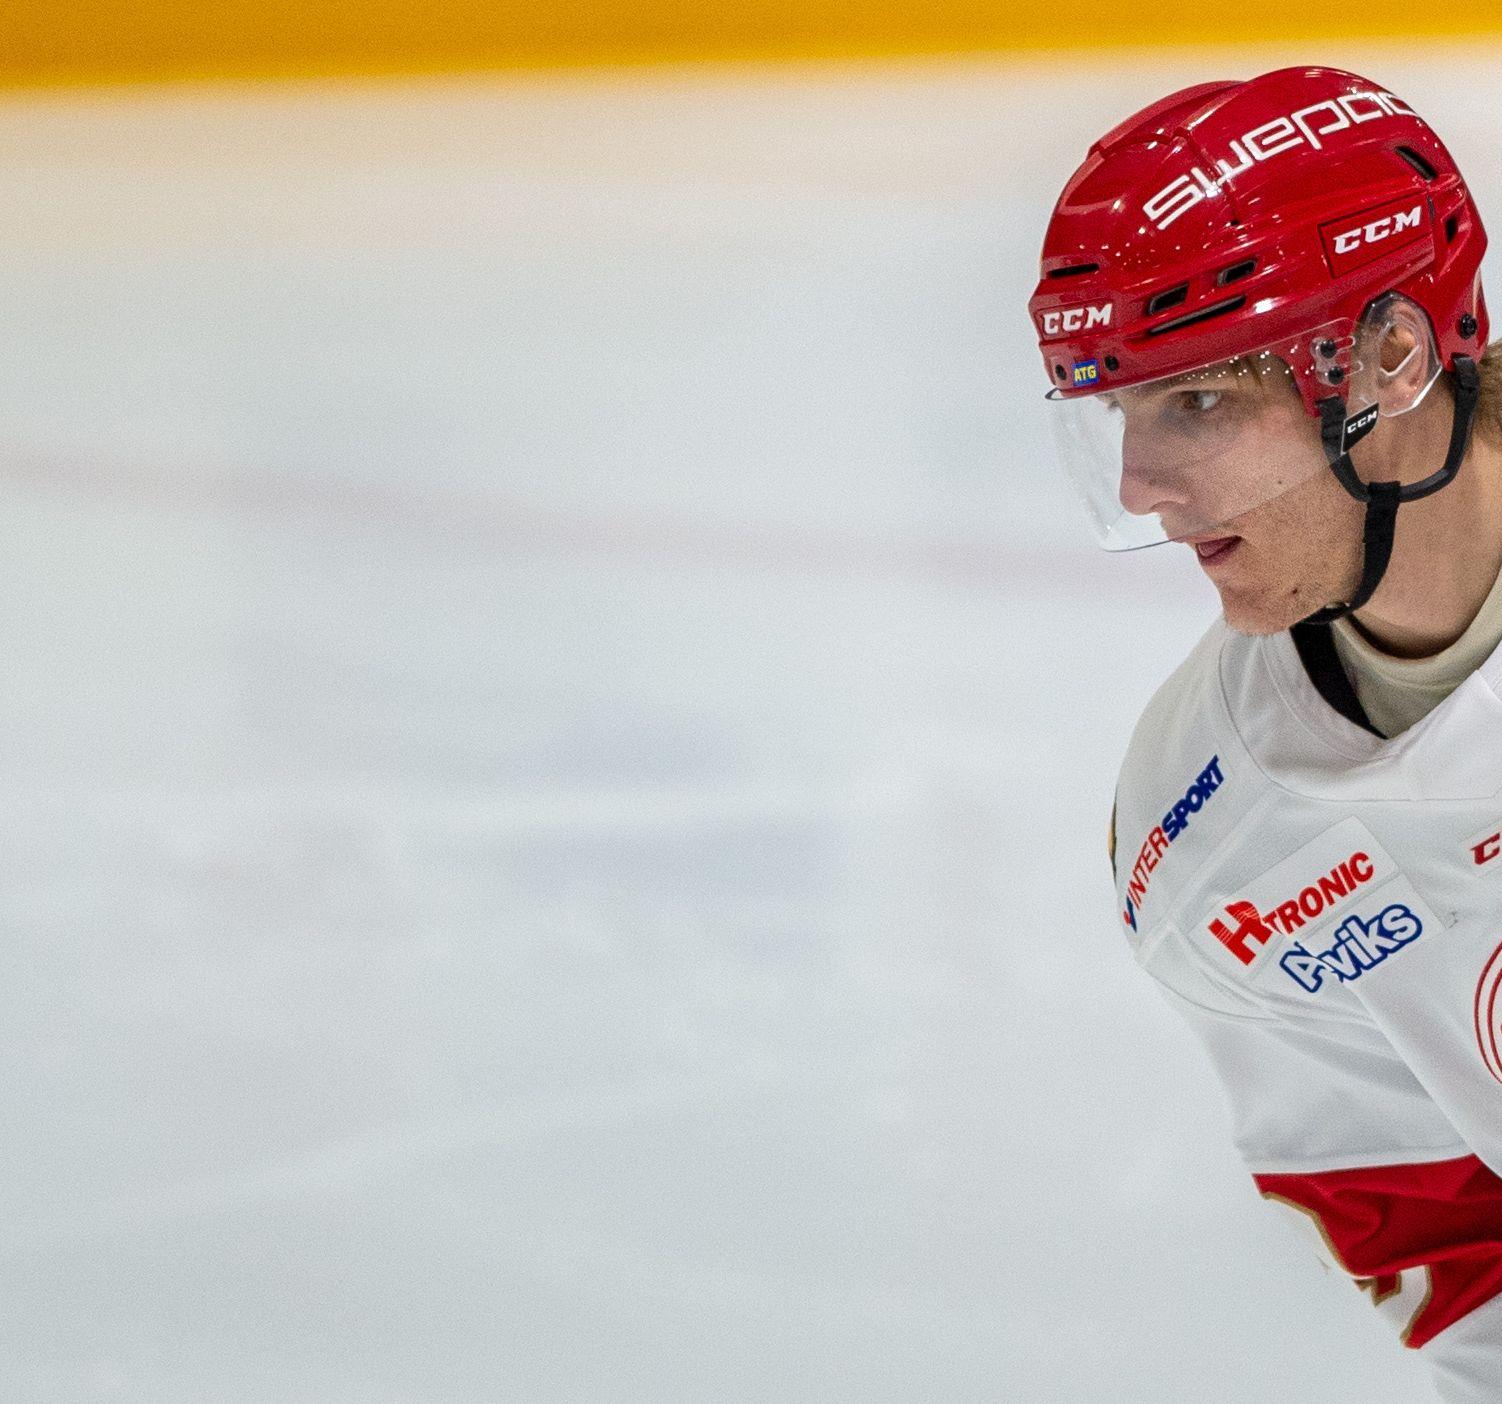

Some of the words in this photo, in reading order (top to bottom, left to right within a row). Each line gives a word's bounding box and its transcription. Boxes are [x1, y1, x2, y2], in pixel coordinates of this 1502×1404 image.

[1332, 206, 1421, 254] CCM
[1043, 303, 1113, 335] CCM
[1074, 365, 1097, 382] ATG
[1347, 410, 1378, 434] CCM
[1127, 754, 1224, 910] INTERSPORT
